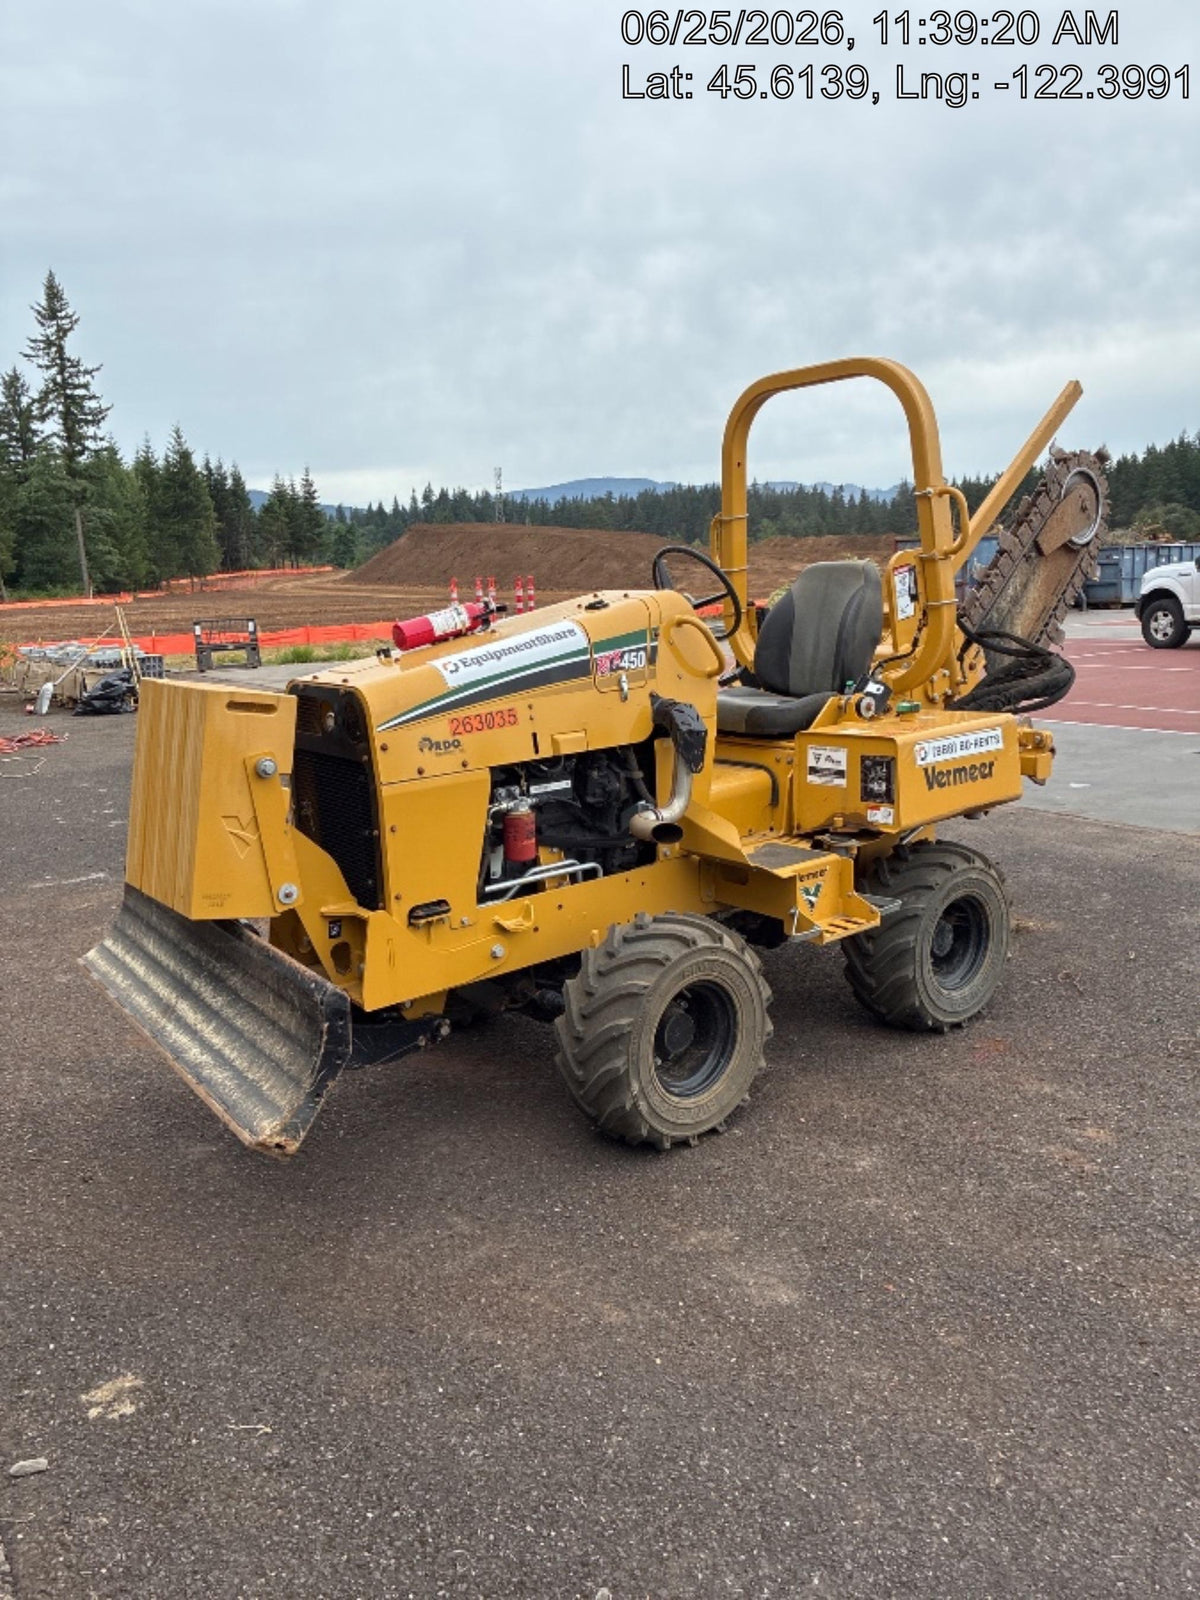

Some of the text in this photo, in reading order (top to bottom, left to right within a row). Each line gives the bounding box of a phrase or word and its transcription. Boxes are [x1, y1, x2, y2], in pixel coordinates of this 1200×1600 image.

[459, 628, 577, 668] EquipmentShare
[450, 708, 519, 736] 263035
[923, 760, 995, 791] Vermeer
